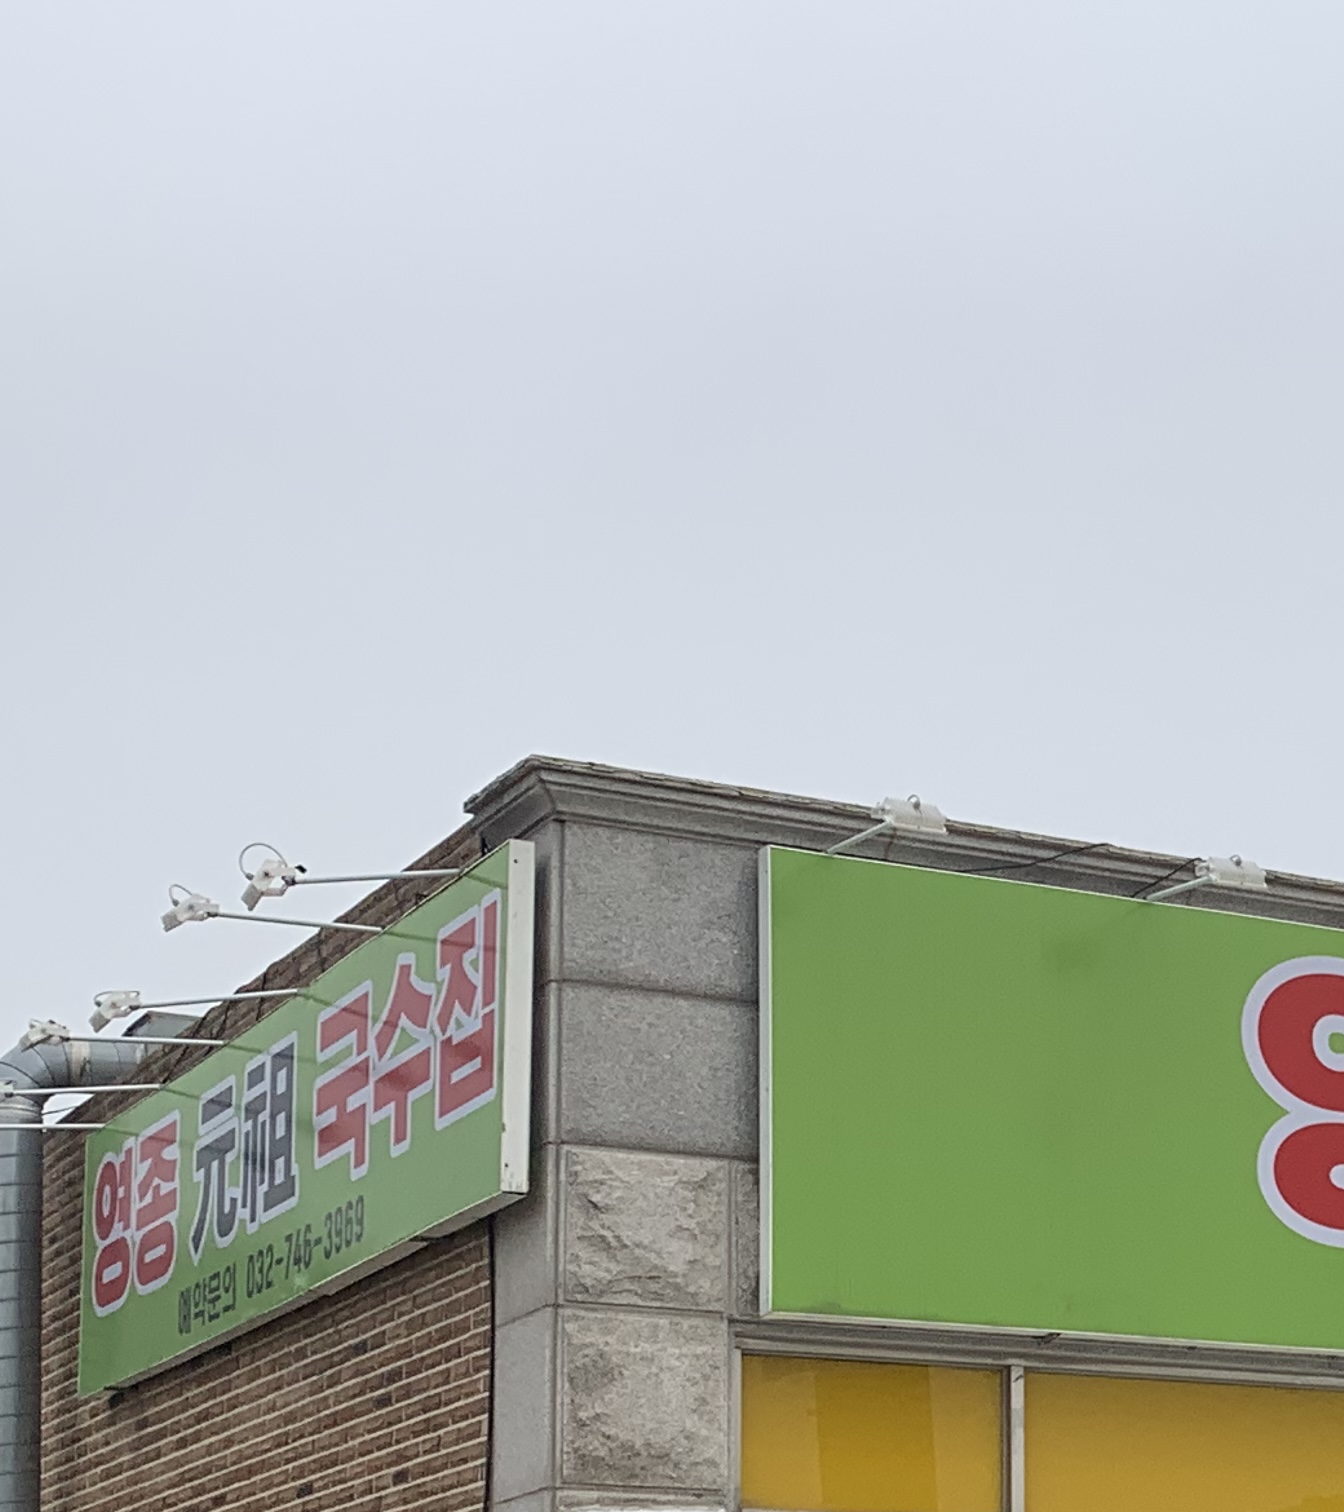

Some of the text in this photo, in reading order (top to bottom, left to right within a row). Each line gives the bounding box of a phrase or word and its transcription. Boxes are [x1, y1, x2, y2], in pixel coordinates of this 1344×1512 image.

[92, 889, 500, 1317] 영종 元祖 국수집
[177, 1194, 366, 1335] 예약문의 032-746-3969
